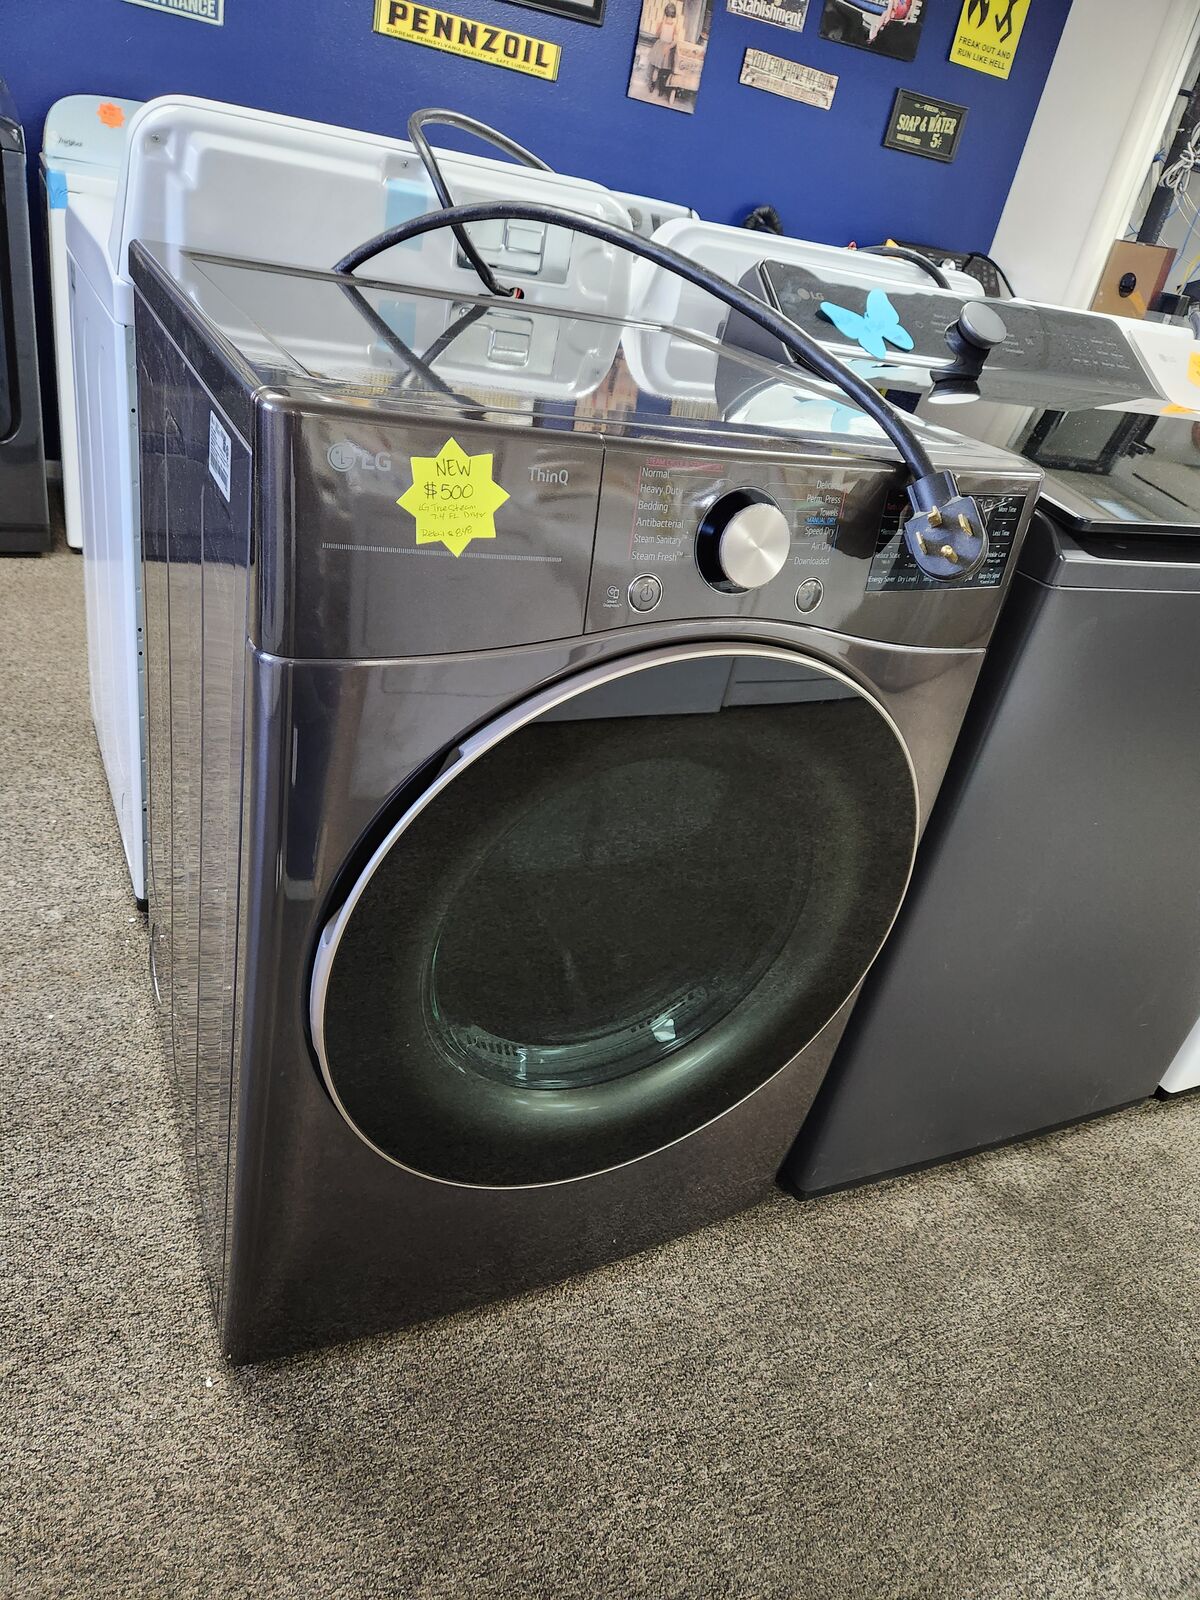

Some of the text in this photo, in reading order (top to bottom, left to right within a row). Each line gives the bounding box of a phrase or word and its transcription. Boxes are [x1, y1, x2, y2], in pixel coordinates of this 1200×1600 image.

[387, 1, 551, 68] PENNZOIL
[386, 27, 547, 76] SUPREME PENNSYLVANIA QUALITY SAFE LUBRICATION
[958, 35, 1011, 60] FREAK OUT AND
[957, 47, 1005, 70] RUN LIKE HELL
[896, 113, 957, 136] SOAP & WATER
[435, 457, 472, 477] NEW
[641, 467, 670, 479] Normal
[527, 466, 569, 487] ThinQ
[423, 481, 474, 500] $500
[639, 483, 684, 497] Heavy Duty
[824, 494, 841, 504] Press
[637, 499, 669, 514] Bedding
[819, 507, 839, 517] Towels
[998, 505, 1008, 513] More
[635, 517, 685, 529] Antibacterial
[804, 526, 836, 538] Speed Dry
[992, 529, 1011, 537] Less Time
[633, 533, 655, 545] Steam
[810, 541, 833, 553] Air Dry
[631, 550, 656, 561] Steam
[793, 556, 830, 566] Downloaded
[867, 575, 897, 585] Energy Saver
[897, 575, 907, 585] Dry
